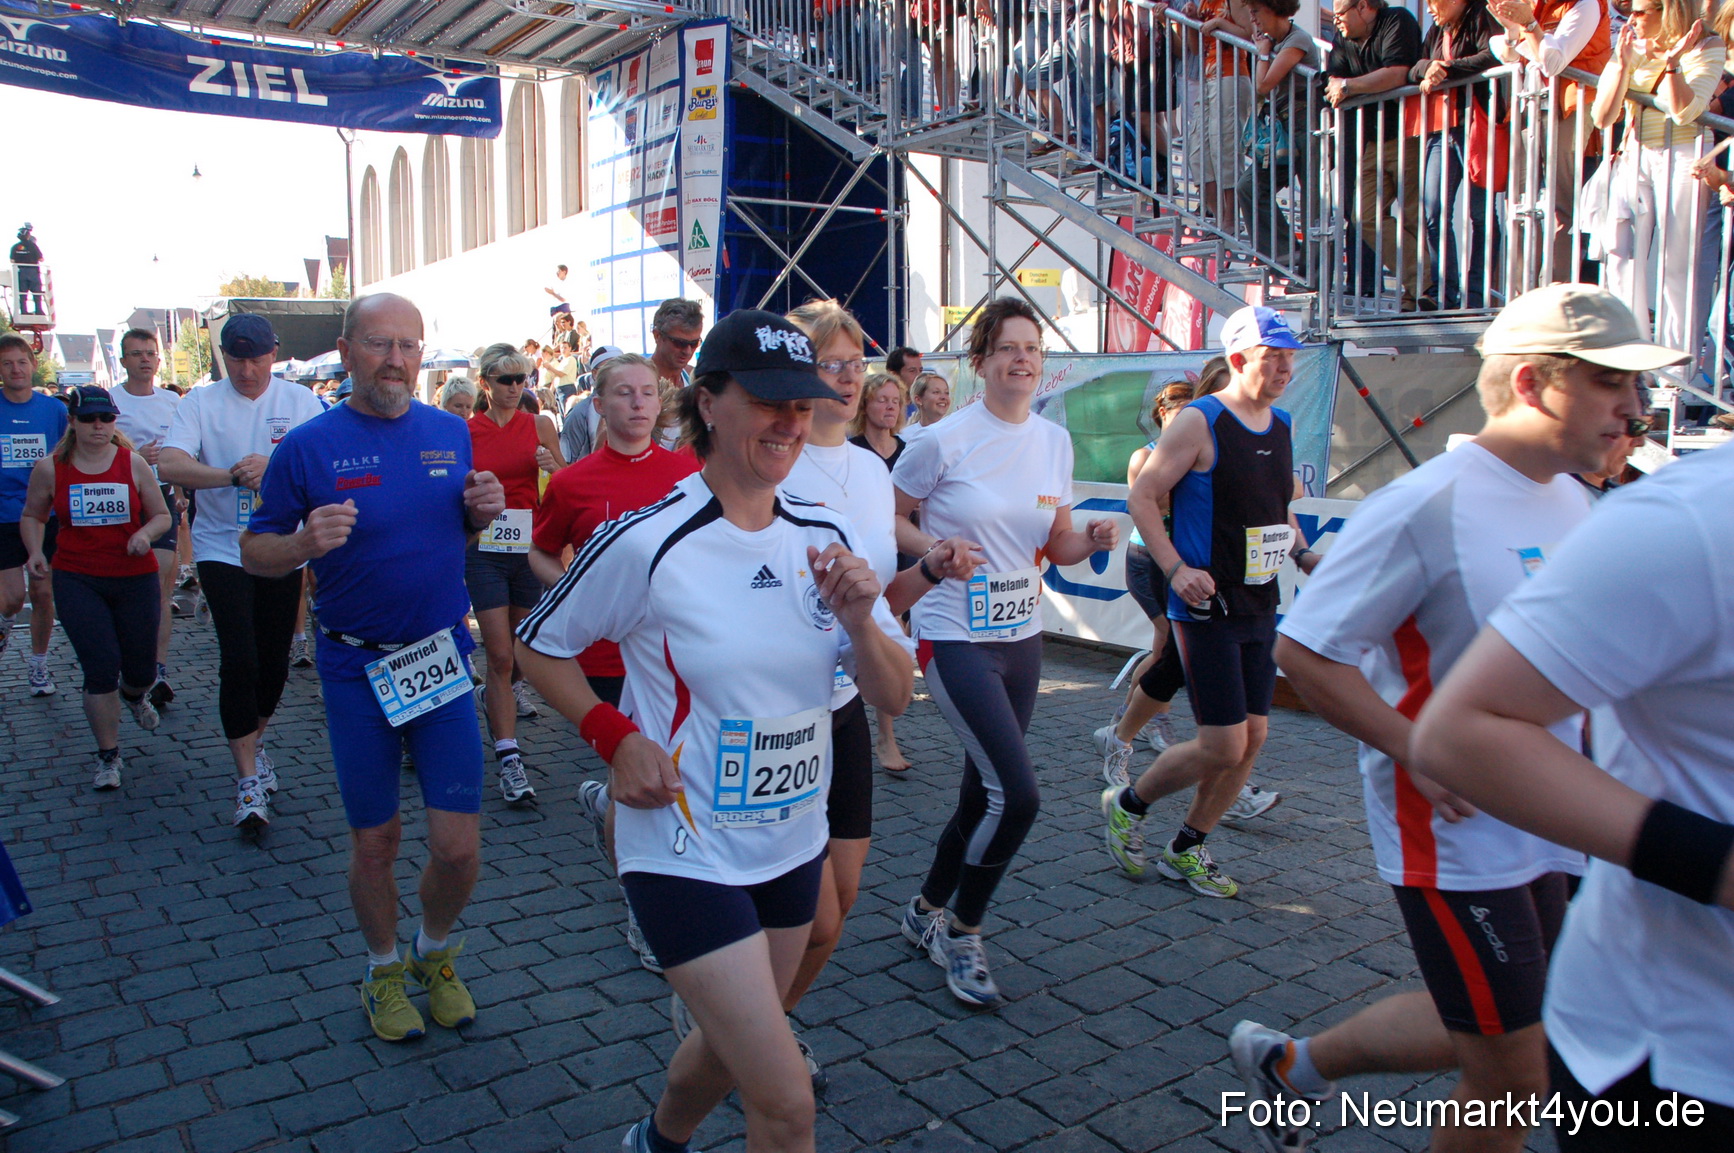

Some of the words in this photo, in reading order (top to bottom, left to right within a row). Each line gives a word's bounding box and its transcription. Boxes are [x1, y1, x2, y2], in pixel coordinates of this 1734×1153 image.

[187, 55, 329, 107] ZIEL
[1036, 363, 1073, 397] Leben
[12, 437, 39, 445] Gerhard
[15, 448, 45, 459] 2856
[333, 455, 381, 470] FALKE
[84, 488, 115, 497] Brigitte
[86, 500, 126, 514] 2488
[241, 502, 249, 511] D
[494, 527, 521, 541] 289
[1262, 531, 1290, 544] Andreas
[1251, 550, 1258, 559] D
[1264, 548, 1286, 569] 775
[751, 579, 783, 590] adidas
[989, 577, 1029, 593] Melanie
[975, 600, 984, 612] D
[992, 596, 1035, 622] 2245
[388, 640, 439, 672] Wilfried
[400, 656, 459, 699] 3294
[378, 683, 390, 696] D
[754, 722, 816, 751] Irmgard
[725, 760, 740, 777] D
[752, 754, 820, 798] 2200
